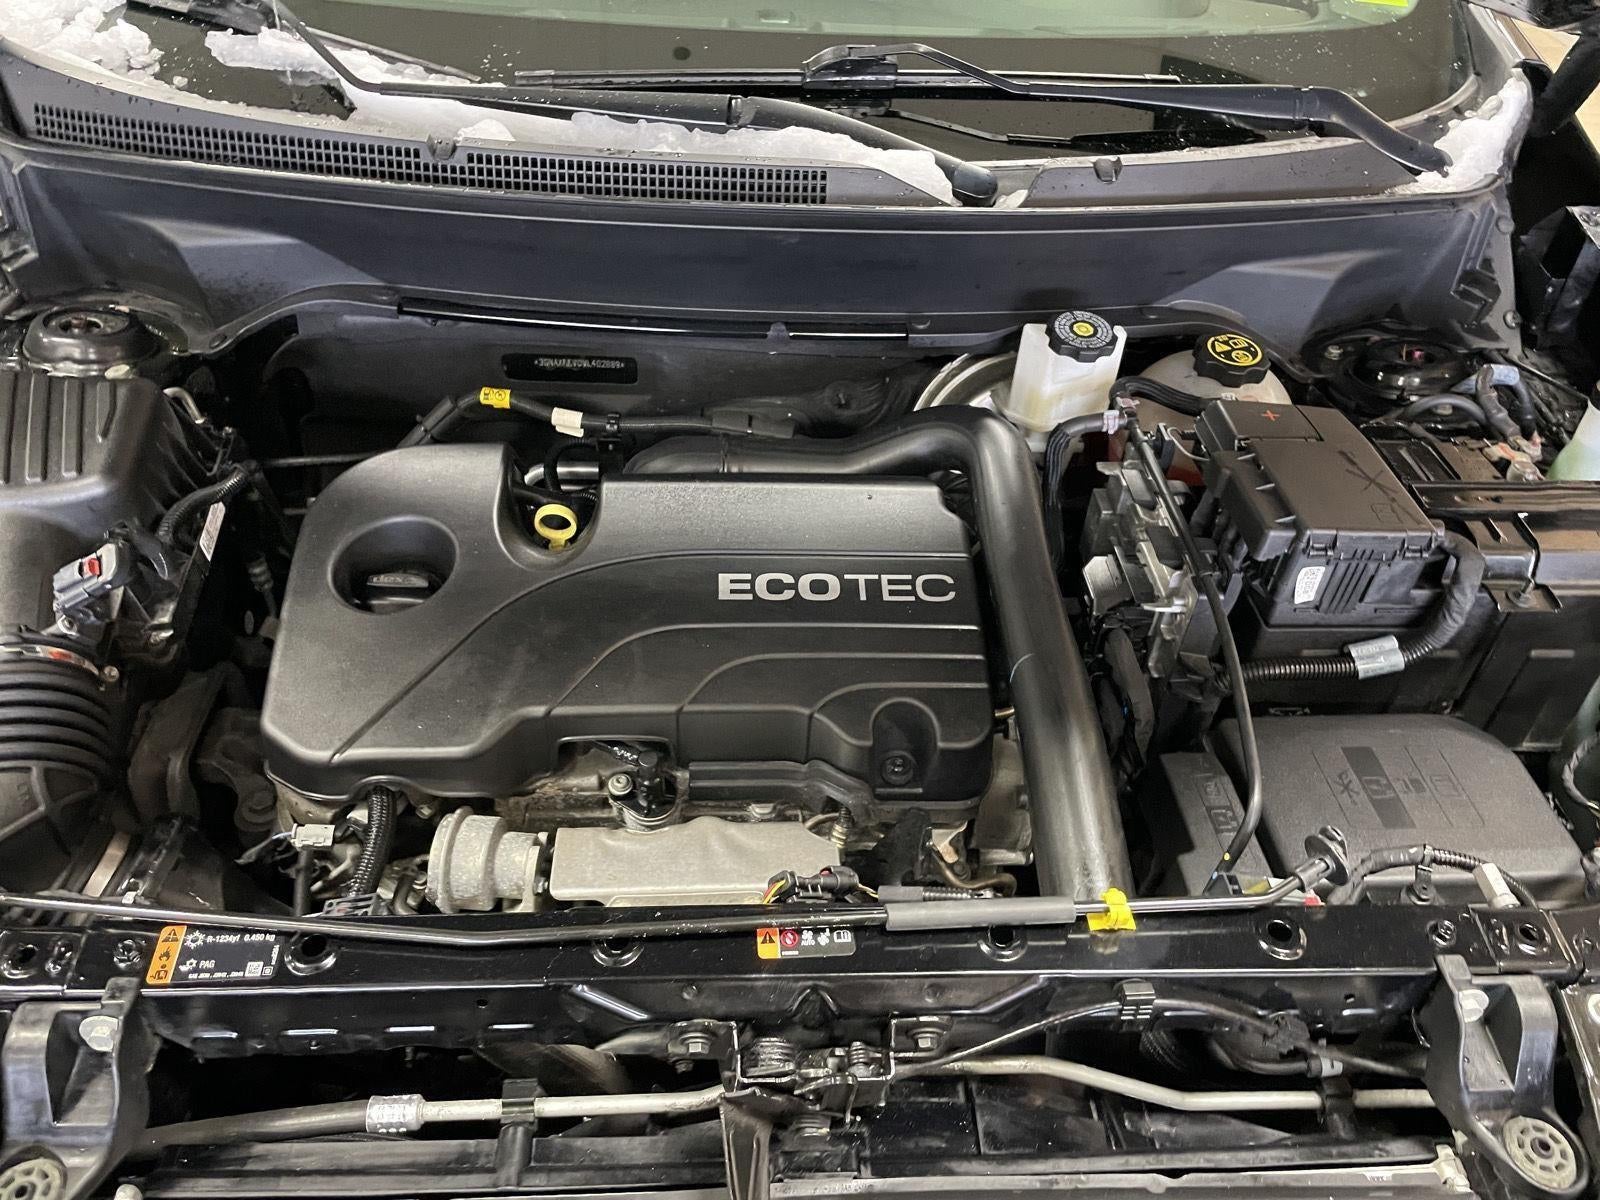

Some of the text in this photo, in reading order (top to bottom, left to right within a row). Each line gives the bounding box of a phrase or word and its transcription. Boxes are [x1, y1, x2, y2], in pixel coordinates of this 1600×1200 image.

[718, 573, 956, 602] ECOTEC
[207, 935, 240, 943] R-1234yf
[199, 960, 215, 969] PAG
